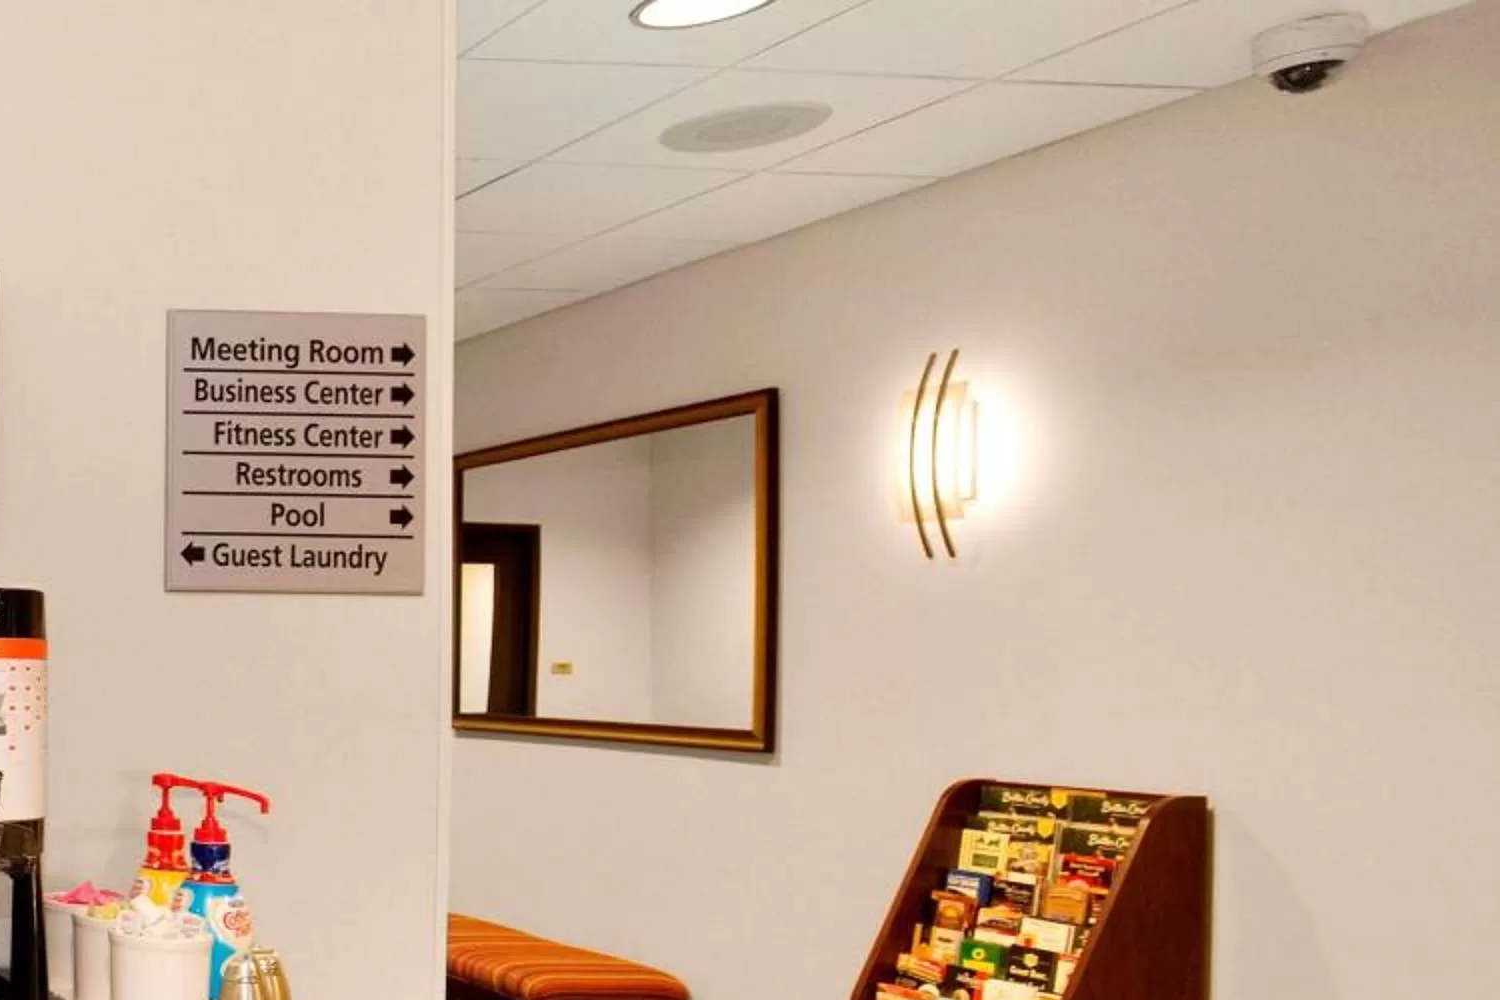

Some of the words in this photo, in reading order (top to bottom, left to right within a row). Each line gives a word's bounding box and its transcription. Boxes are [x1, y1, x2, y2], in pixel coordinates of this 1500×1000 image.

[190, 336, 300, 369] Meeting
[308, 339, 384, 364] Room
[194, 378, 297, 403] Business
[303, 380, 384, 406] Center
[213, 420, 296, 447] Fitness
[303, 423, 384, 448] Center
[235, 462, 363, 488] Restrooms
[270, 502, 325, 527] Pool
[211, 543, 283, 568] Guest
[290, 544, 388, 576] Laundry
